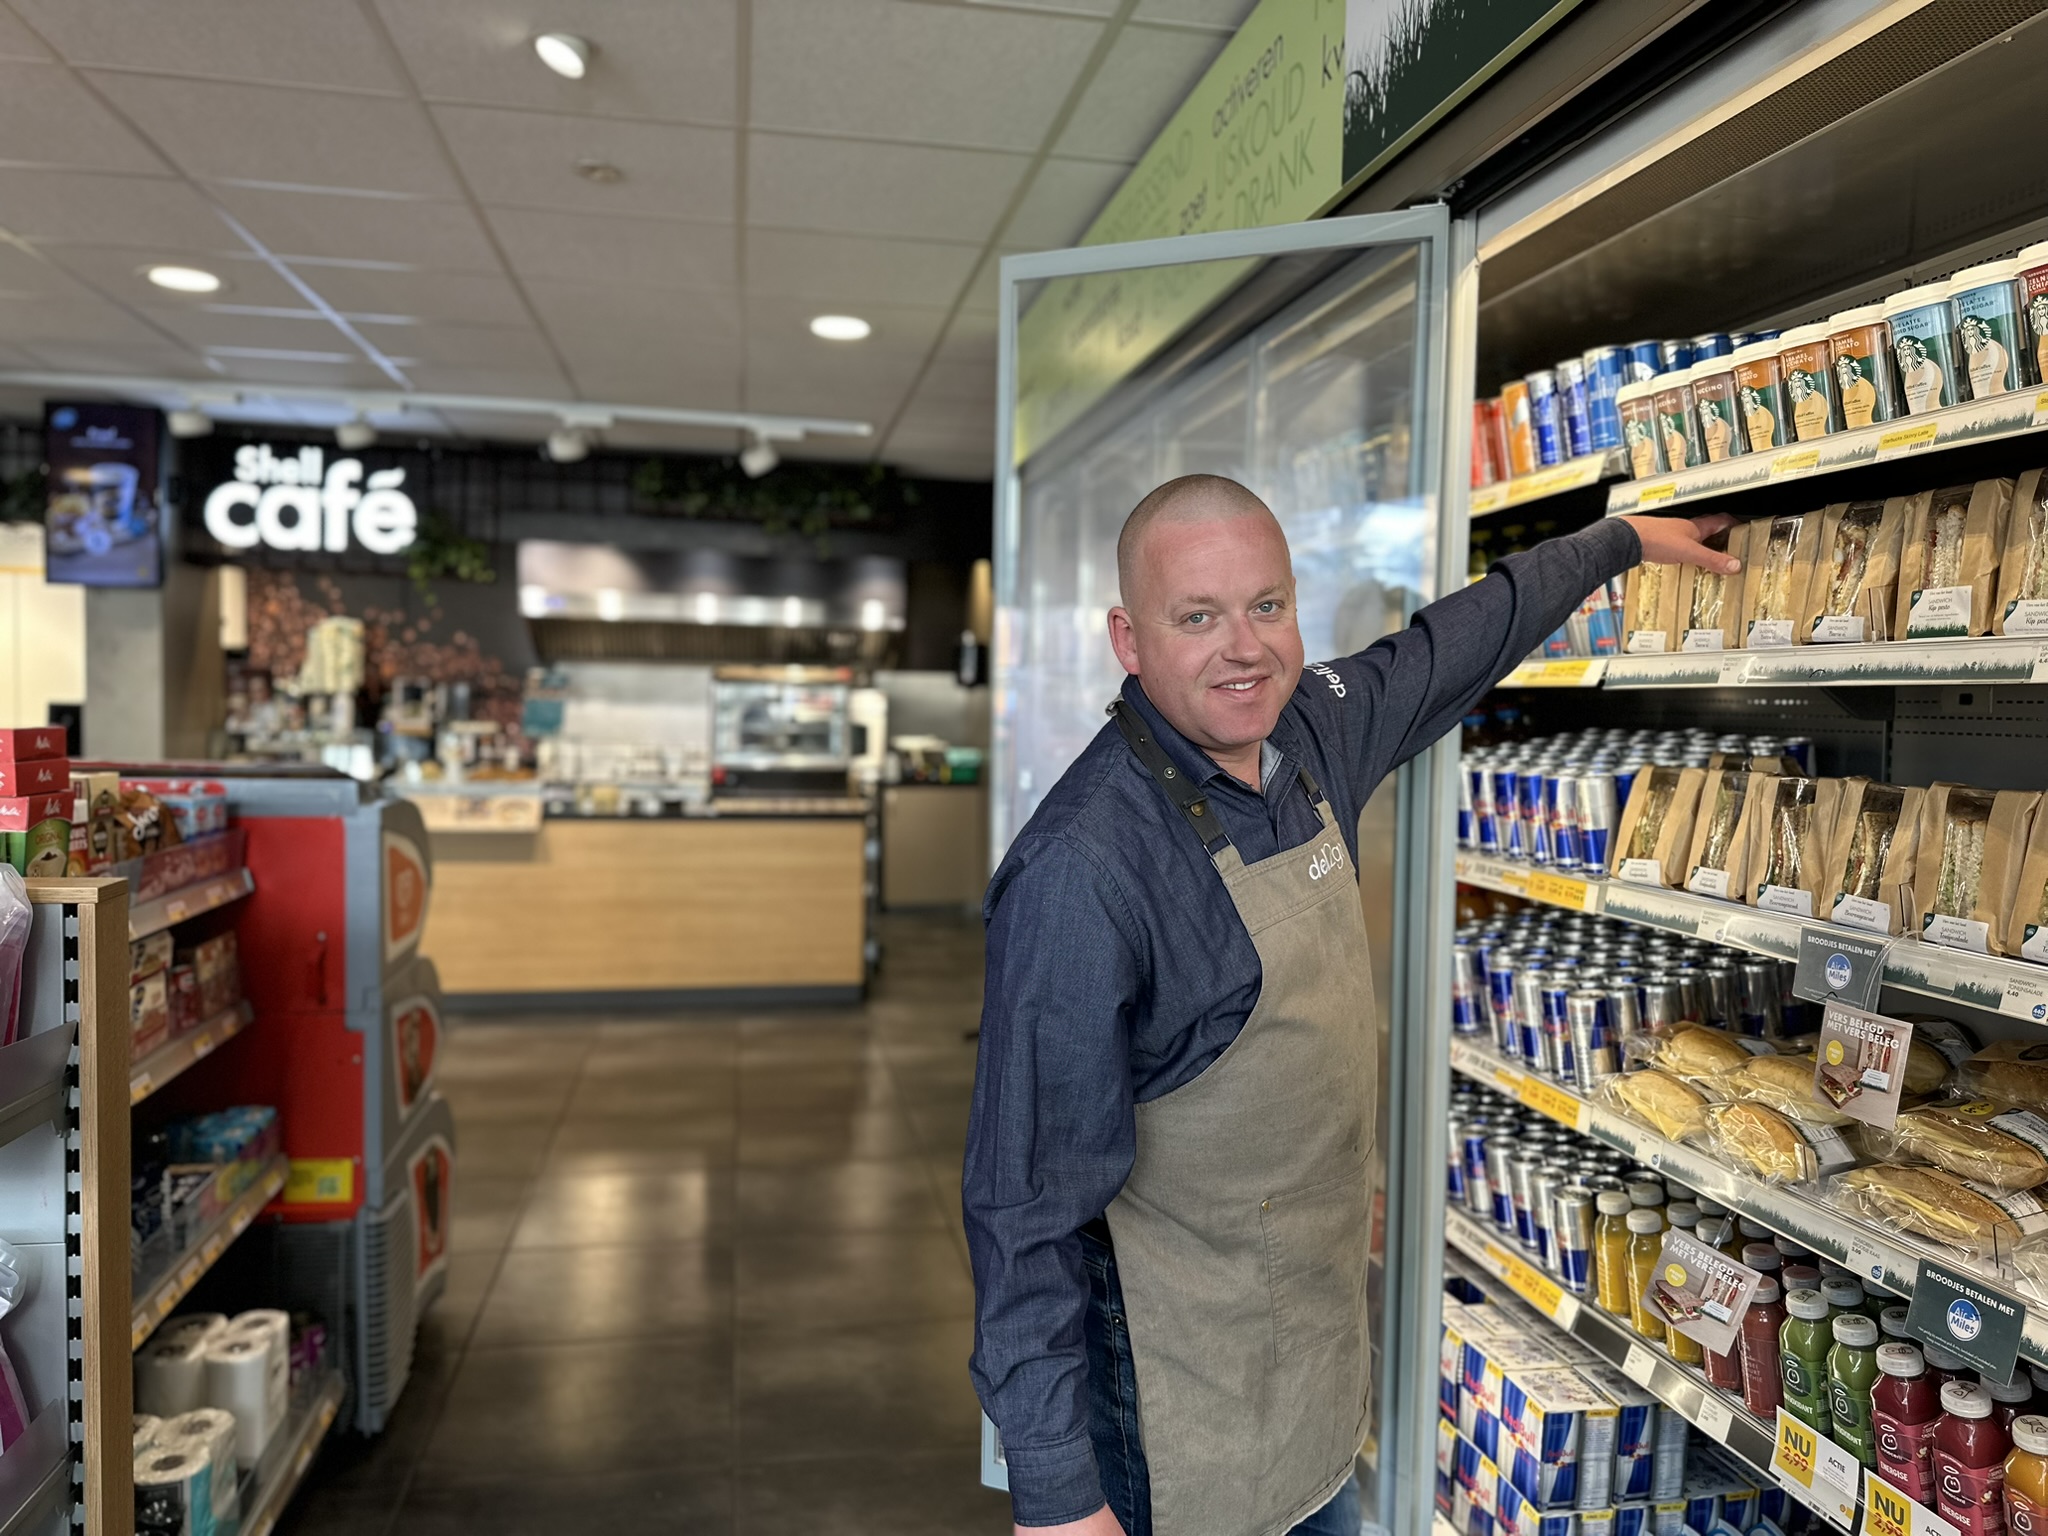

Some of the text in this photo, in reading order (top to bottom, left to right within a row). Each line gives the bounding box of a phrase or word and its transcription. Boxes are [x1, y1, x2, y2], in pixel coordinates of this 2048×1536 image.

[234, 444, 323, 483] Shell
[204, 457, 418, 554] café
[1807, 935, 1877, 958] BROODJES BETALEN MET
[1829, 970, 1847, 982] Miles
[1831, 961, 1842, 970] Air
[2009, 977, 2037, 988] SANDWICH
[1827, 1020, 1899, 1050] MET VERS BELEG
[1829, 1011, 1885, 1035] VERS BELEGD
[1673, 1236, 1735, 1276] VERS BELEGD
[1669, 1245, 1747, 1292] MET VERS BELEG
[1926, 1269, 2015, 1317] BROODJES BETALEN MET
[1954, 1306, 1968, 1319] Air
[1951, 1316, 1975, 1335] Miles
[1784, 1425, 1810, 1458] NU
[1782, 1446, 1808, 1472] 2,99
[1828, 1457, 1846, 1473] ACTIE
[1880, 1461, 1908, 1482] ENERGISE
[1874, 1490, 1904, 1525] NU
[1940, 1502, 1971, 1526] ENERGISE
